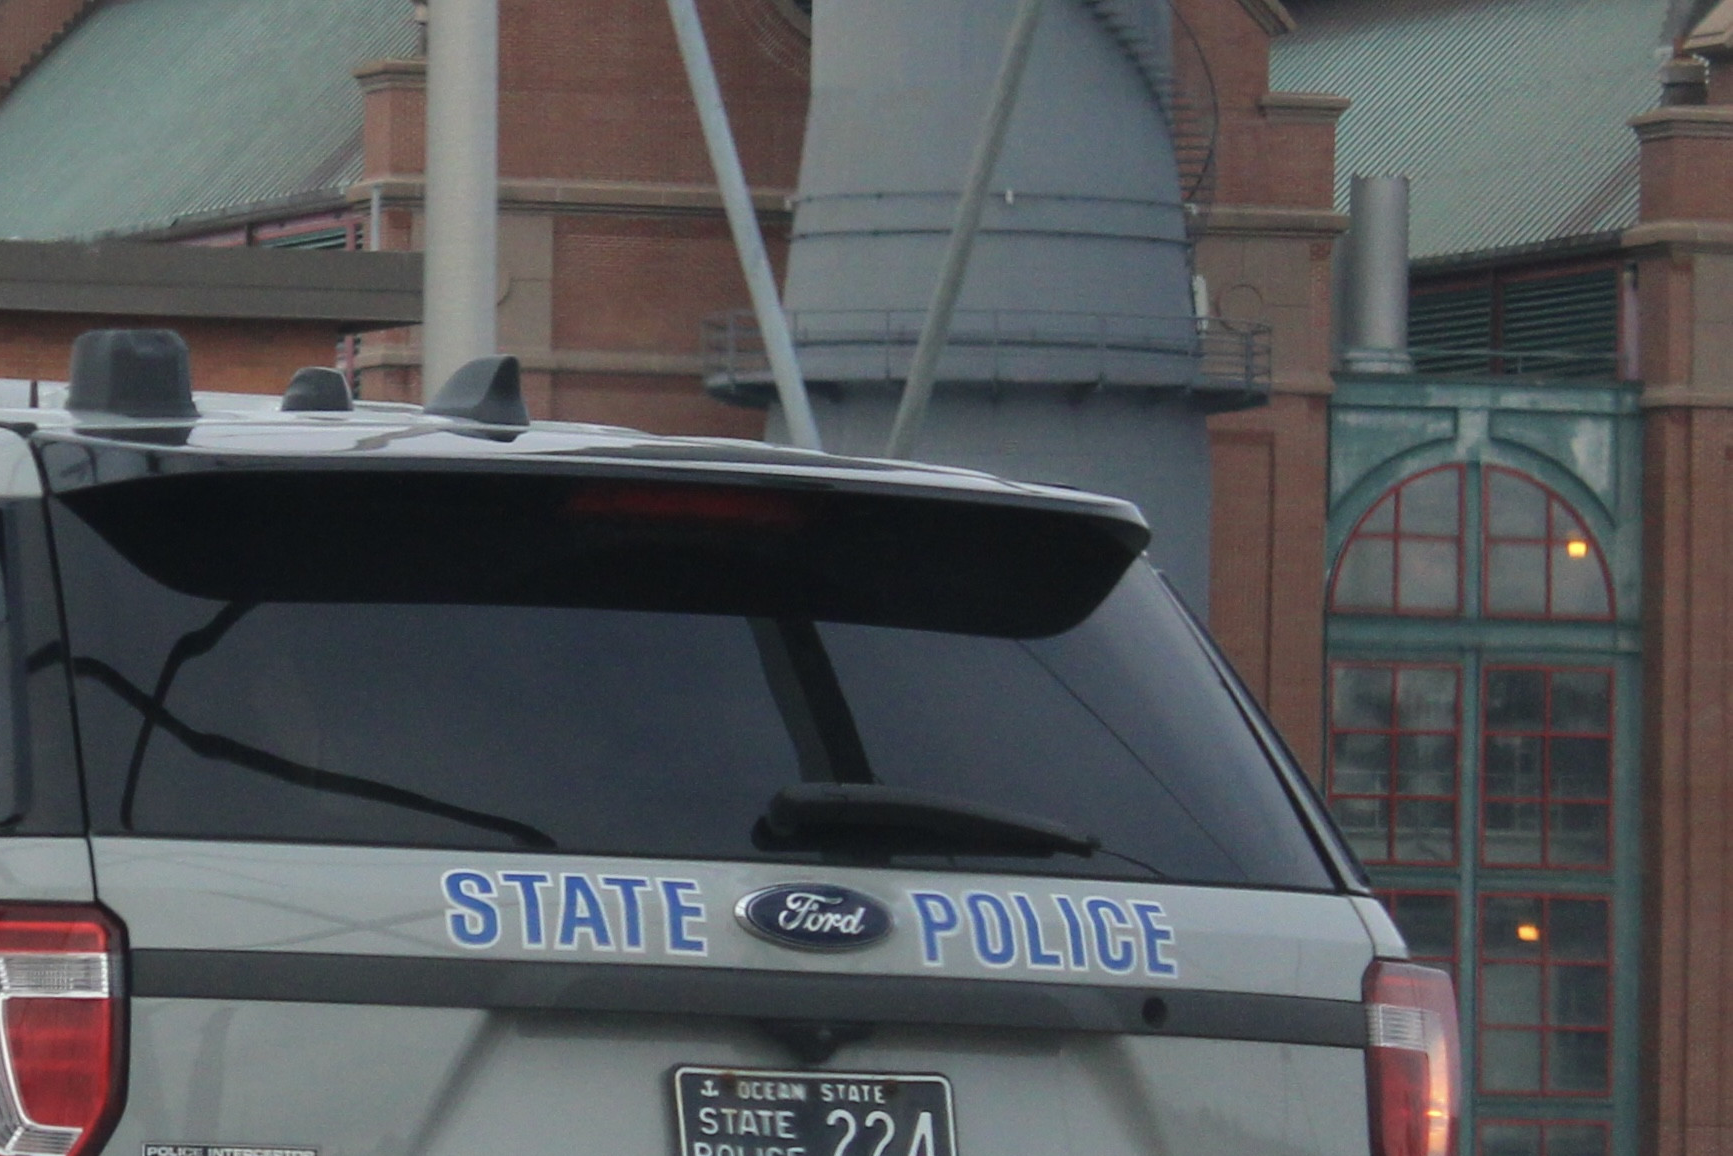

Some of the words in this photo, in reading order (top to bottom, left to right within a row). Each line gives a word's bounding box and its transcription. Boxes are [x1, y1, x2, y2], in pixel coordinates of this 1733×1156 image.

[440, 868, 708, 957] STATE
[907, 889, 1179, 979] POLICE
[778, 892, 866, 934] Ford
[736, 1080, 807, 1102] OCEAN
[820, 1083, 887, 1104] STATE
[698, 1106, 798, 1140] STATE
